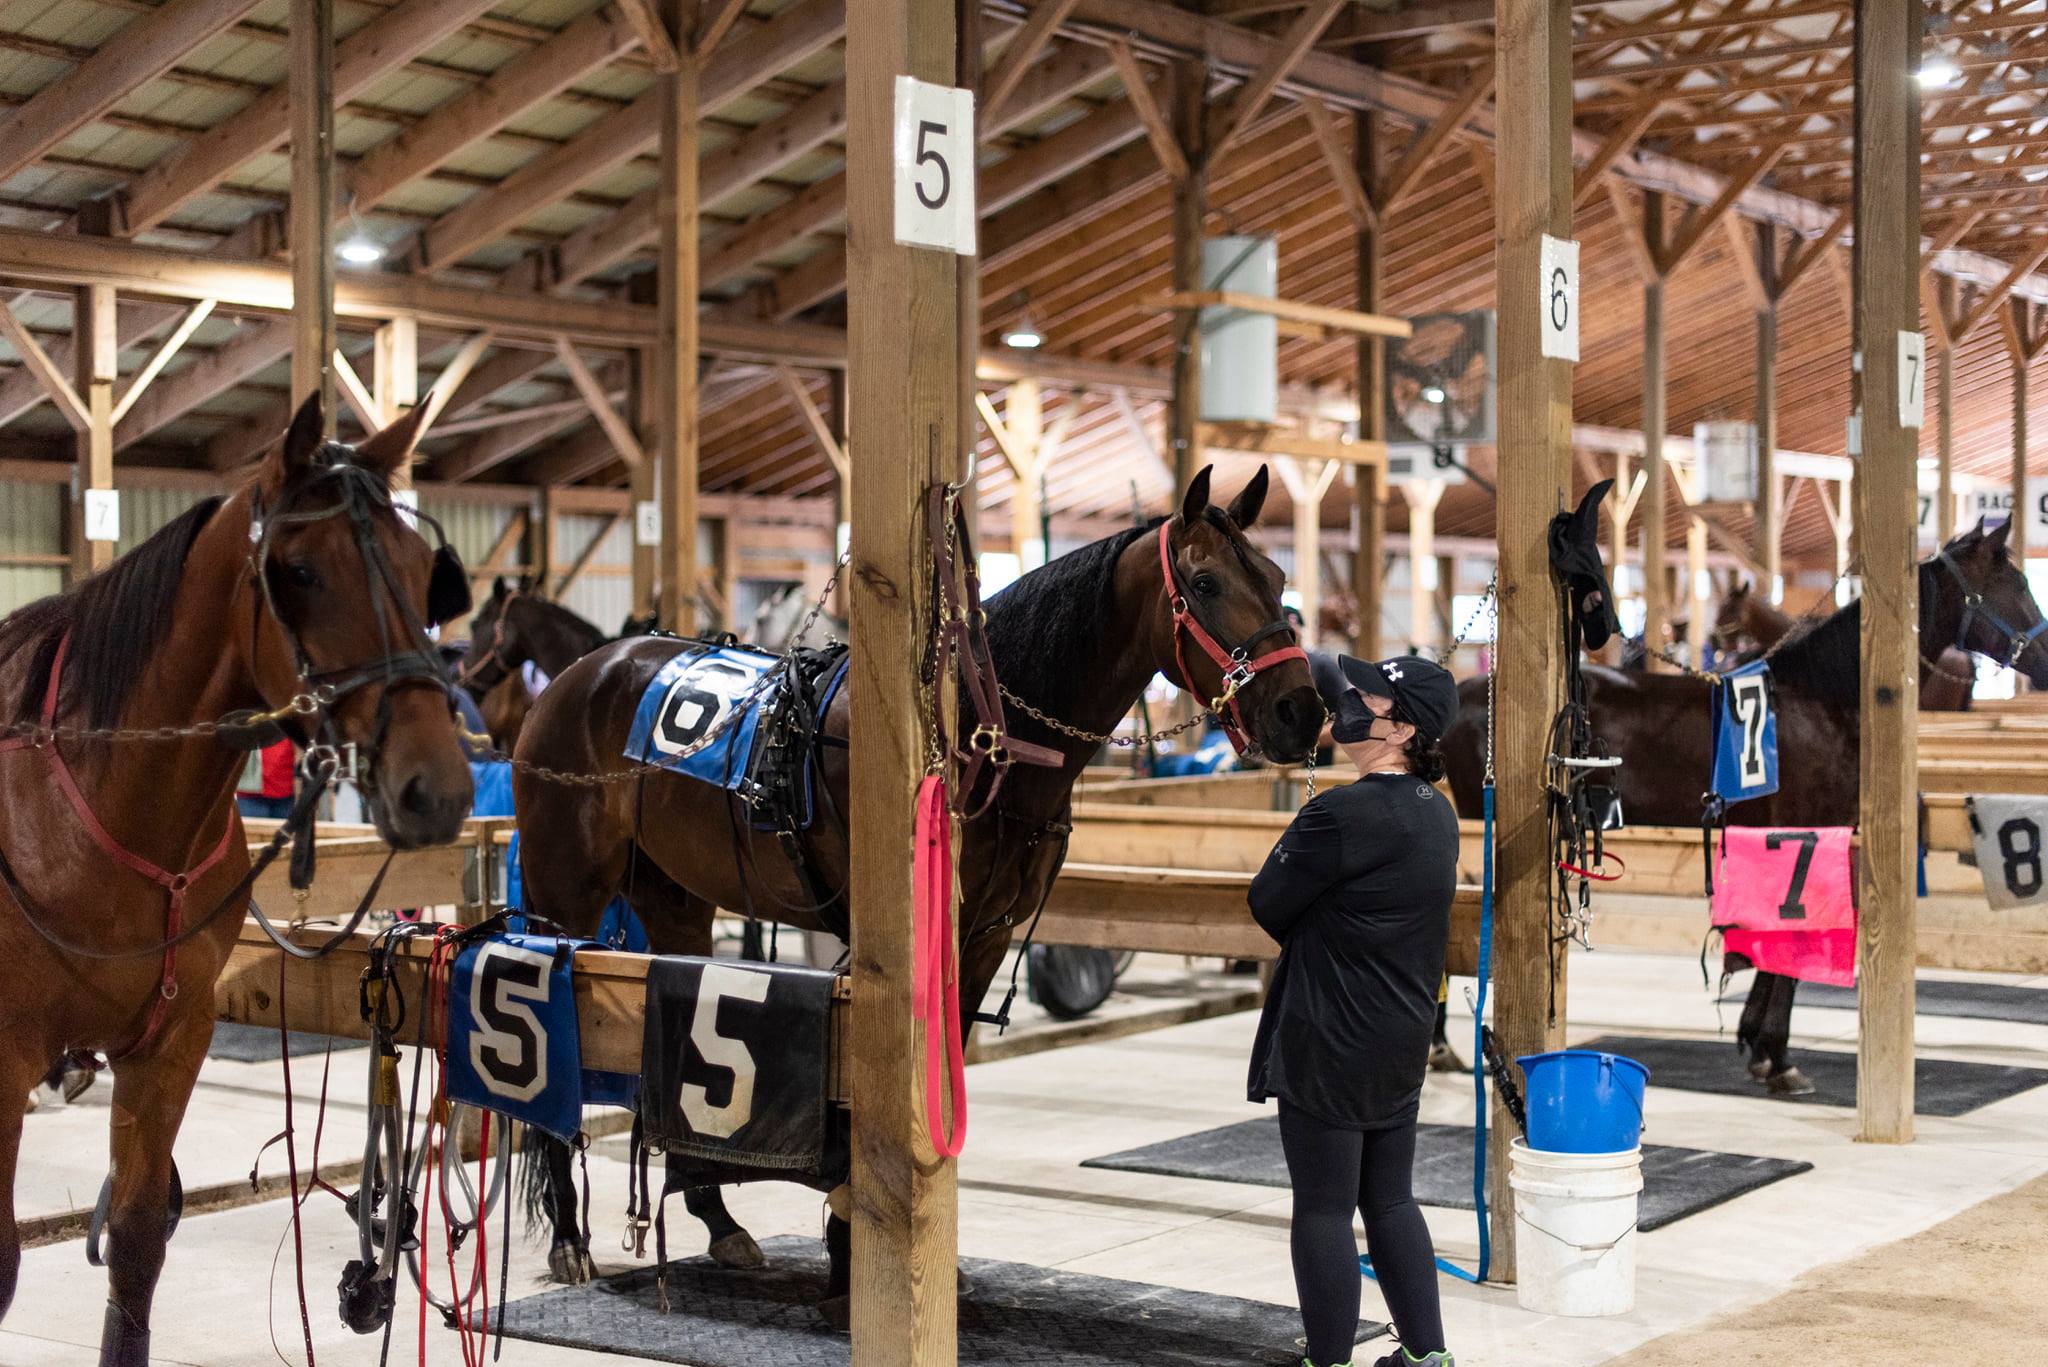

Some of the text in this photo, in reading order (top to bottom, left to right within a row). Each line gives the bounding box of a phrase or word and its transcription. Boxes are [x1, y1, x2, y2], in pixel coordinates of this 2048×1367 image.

[915, 120, 950, 210] 5
[1551, 267, 1568, 331] 6
[1907, 354, 1918, 404] 7
[97, 501, 109, 528] 7
[1917, 496, 1932, 525] 7
[656, 660, 754, 757] 6
[1735, 679, 1766, 784] 7
[1766, 832, 1818, 919] 7
[1997, 817, 2043, 899] 8
[472, 944, 553, 1100] 5
[680, 964, 771, 1139] 5
